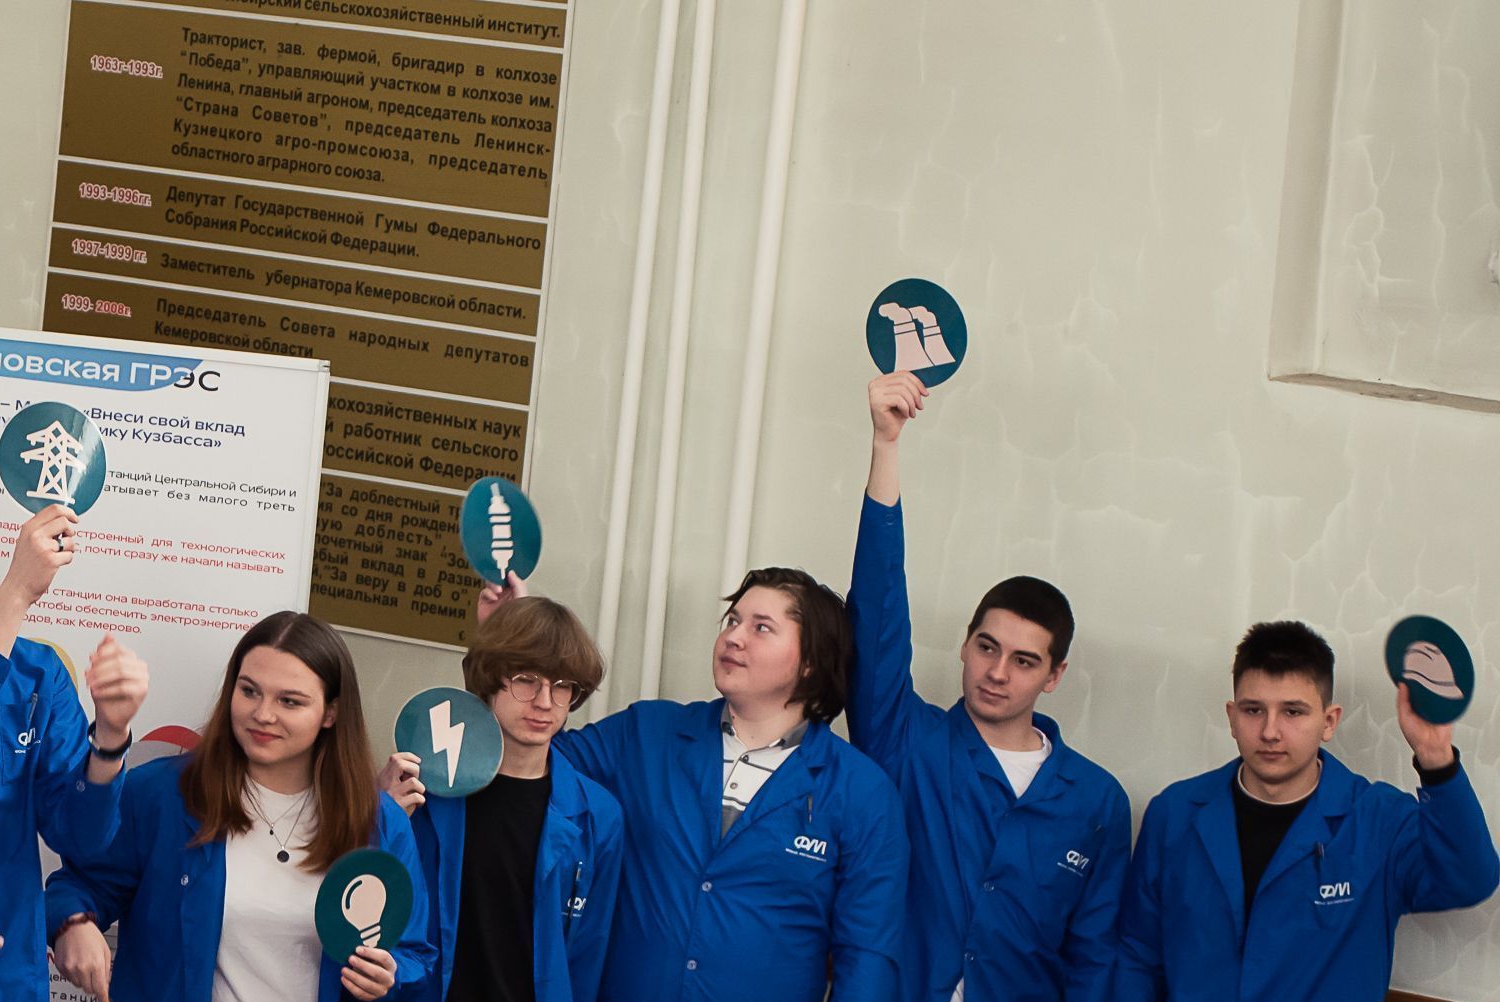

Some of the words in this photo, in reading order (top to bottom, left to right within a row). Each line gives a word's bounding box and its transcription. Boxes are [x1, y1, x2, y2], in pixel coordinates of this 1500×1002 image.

[304, 0, 484, 28] сельскохозяйственный
[487, 19, 560, 39] институт.
[182, 27, 266, 53] Тракторист,
[277, 42, 305, 56] зав.
[317, 44, 380, 66] фермой,
[391, 52, 464, 77] бригадир
[475, 64, 485, 77] в
[495, 67, 557, 85] колхозе
[258, 63, 364, 86] управляющий
[370, 76, 441, 95] участком
[446, 85, 456, 97] в
[462, 87, 523, 105] колхозе
[529, 95, 554, 109] им.
[177, 73, 234, 95] Ленина,
[239, 84, 302, 101] главный
[306, 92, 373, 112] агроном,
[378, 101, 486, 124] председатель
[491, 115, 552, 133] колхоза
[173, 118, 262, 143] Кузнецкого
[275, 134, 413, 164] агро-промсоюза,
[428, 154, 547, 179] председатель
[345, 120, 460, 145] председатель
[474, 132, 550, 155] Ленинск-
[171, 141, 254, 165] областного
[257, 155, 332, 175] аграрного
[334, 165, 384, 182] союза.
[165, 185, 225, 207] Депутат
[234, 194, 364, 225] Государственной
[427, 221, 541, 250] Федерального
[165, 208, 237, 231] Собрания
[240, 218, 327, 244] Российской
[330, 232, 419, 257] Федерации.
[72, 239, 131, 259] 1997-1999
[161, 253, 255, 280] Заместитель
[265, 269, 352, 295] убернатора
[355, 281, 455, 308] Кемеровской
[458, 297, 525, 319] области.
[154, 321, 250, 348] Кемеровской
[252, 337, 315, 360] области
[156, 298, 266, 328] Председатель
[280, 316, 335, 338] Совета
[348, 330, 429, 352] народных
[444, 344, 529, 367] депутатов
[129, 362, 221, 392] ГРЭС
[148, 416, 190, 429] свой
[195, 421, 245, 437] вклад
[328, 396, 477, 430] кохозяйственных
[482, 420, 521, 440] наук
[132, 428, 221, 447] Кузбасса»
[343, 422, 421, 446] работник
[431, 437, 518, 462] сельского
[154, 474, 236, 490] Центральной
[239, 483, 286, 496] Сибири
[167, 490, 190, 500] без
[198, 494, 248, 507] малого
[256, 501, 295, 512] треть
[350, 489, 440, 513] доблестный
[84, 545, 121, 556] почти
[123, 550, 159, 562] сразу
[161, 554, 178, 562] же
[180, 556, 223, 567] начали
[226, 561, 284, 574] называть
[150, 538, 173, 547] для
[181, 541, 285, 559] технологических
[361, 558, 404, 577] вклад
[35, 599, 72, 611] чтобы
[75, 605, 147, 620] обеспечить
[52, 588, 102, 600] станции
[105, 594, 128, 603] она
[131, 597, 205, 612] выработала
[208, 606, 258, 618] столько
[411, 600, 466, 619] премия
[55, 617, 75, 626] как
